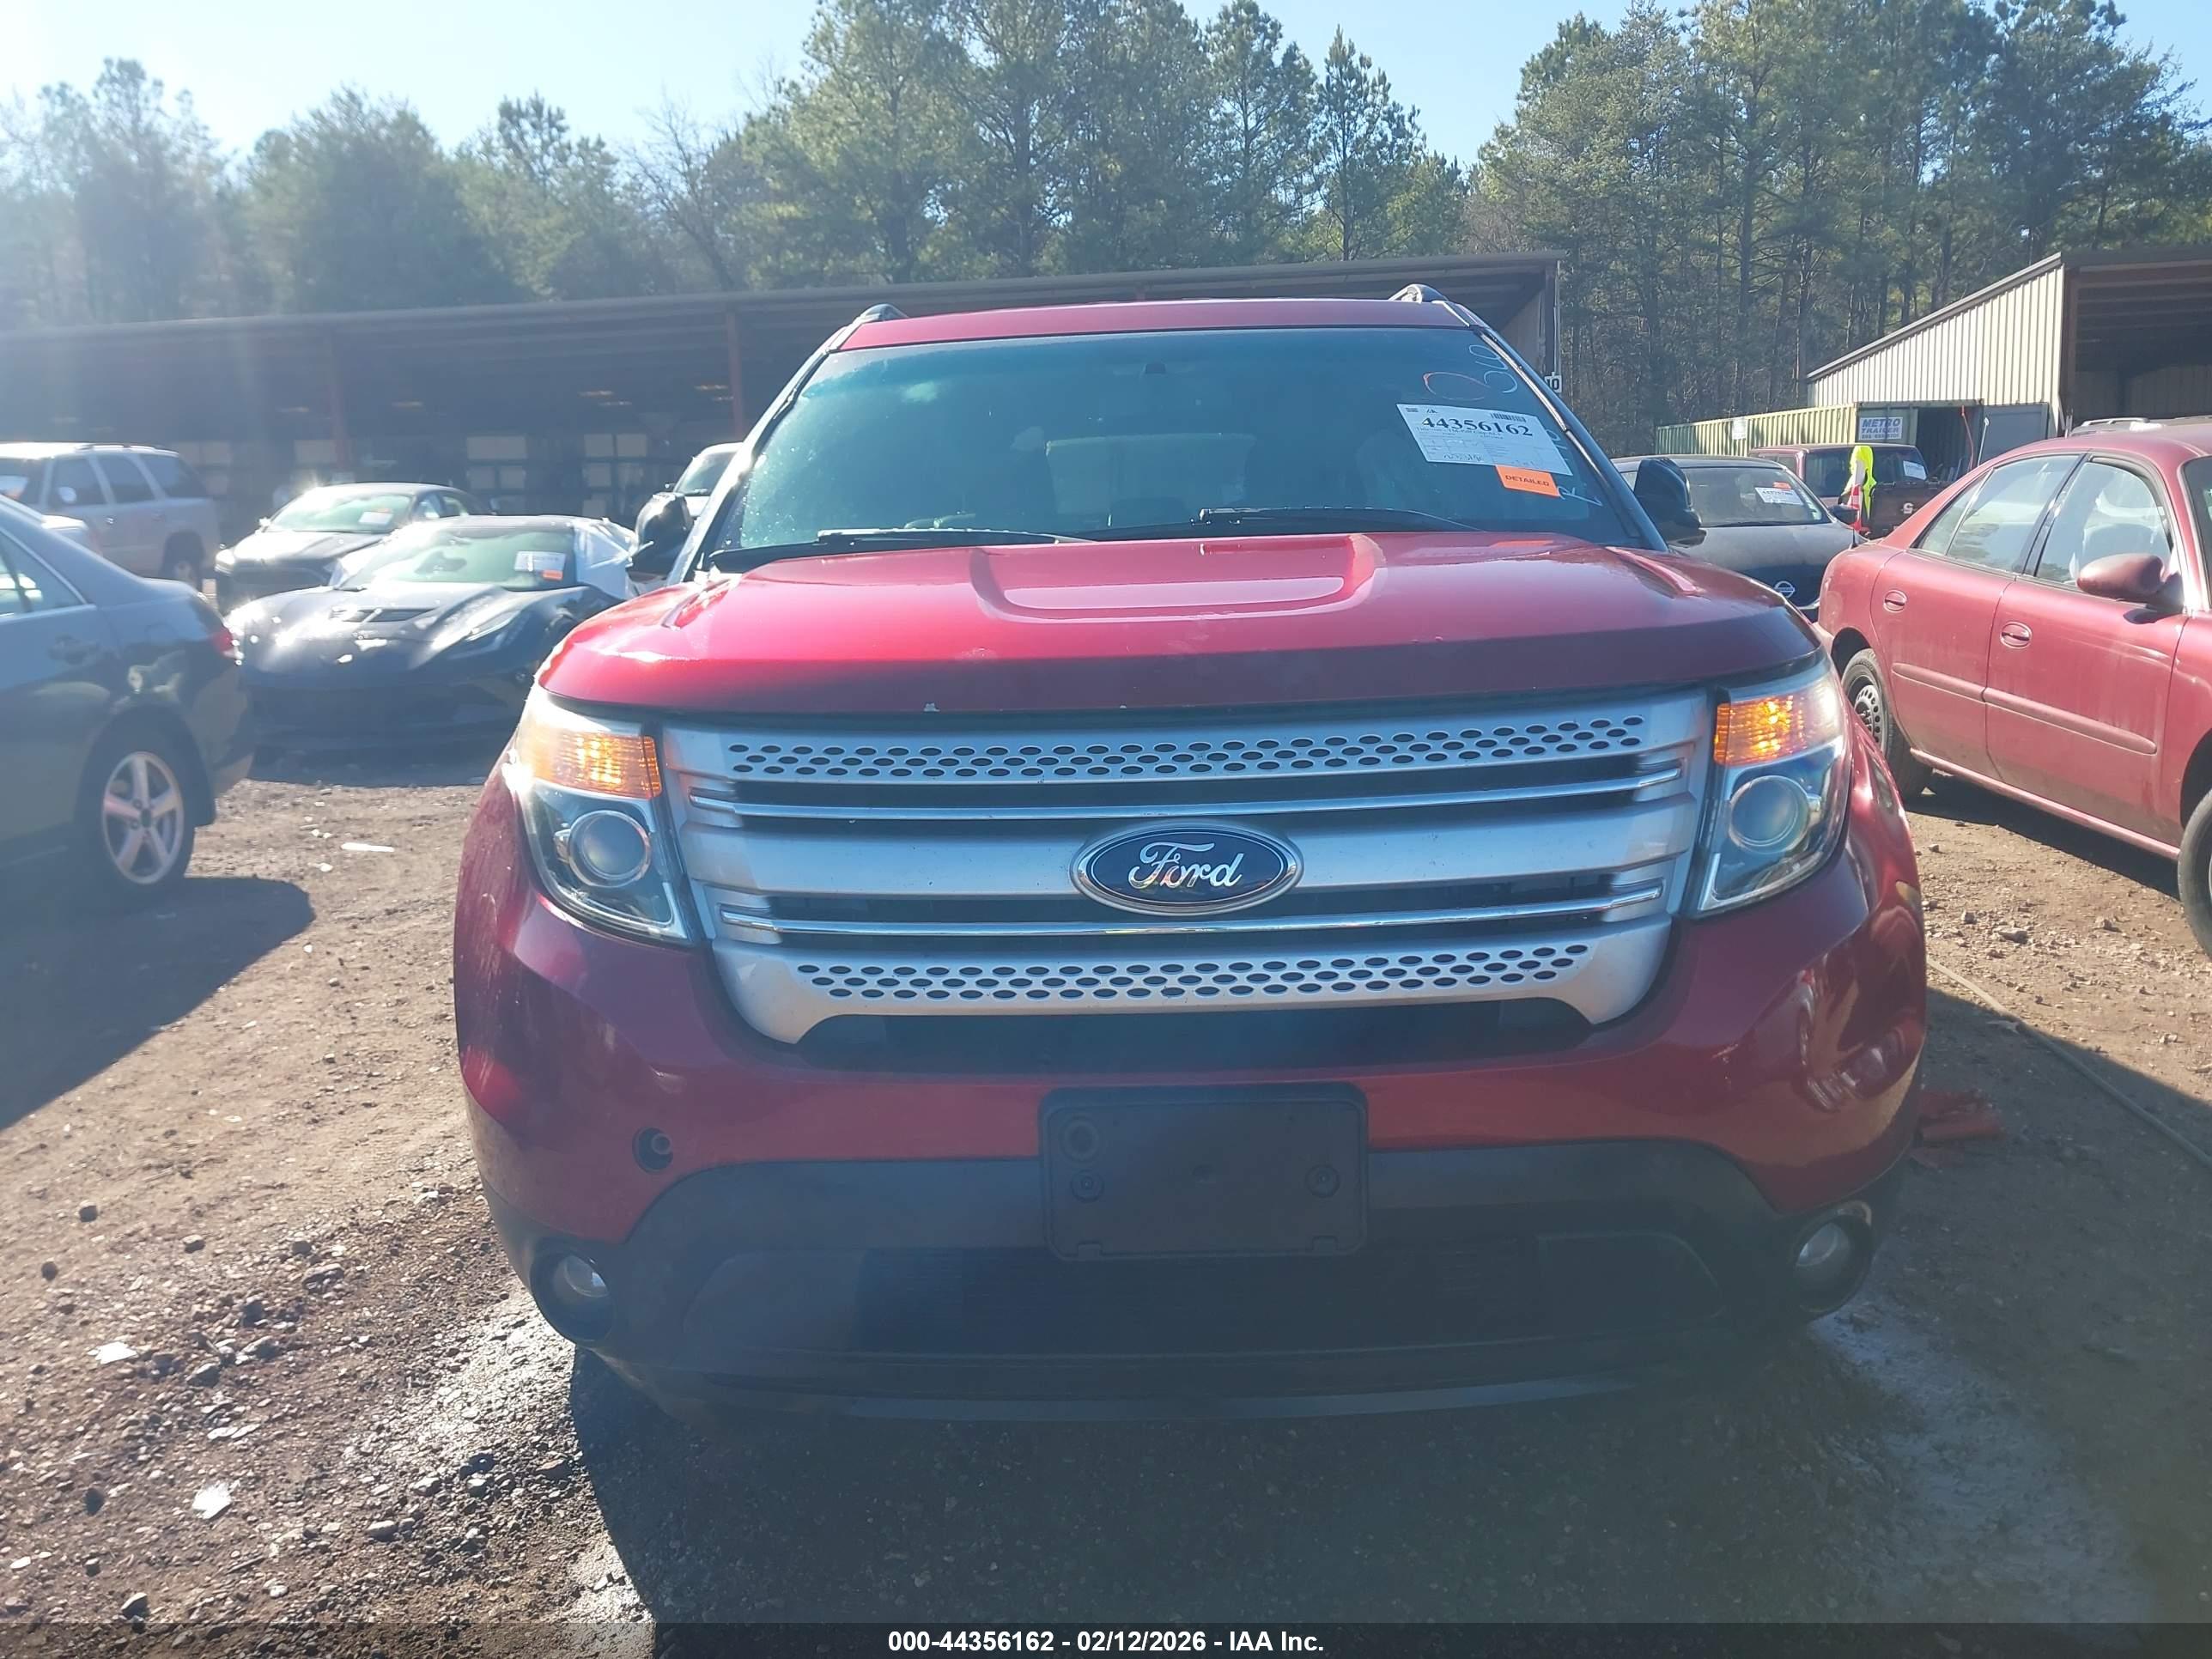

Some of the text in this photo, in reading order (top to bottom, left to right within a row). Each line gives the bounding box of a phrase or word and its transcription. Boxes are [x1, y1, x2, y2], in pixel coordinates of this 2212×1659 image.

[1422, 417, 1533, 436] 44356162
[1862, 418, 1900, 428] METRO
[1505, 474, 1550, 487] DETAILED
[1128, 842, 1244, 889] Ford
